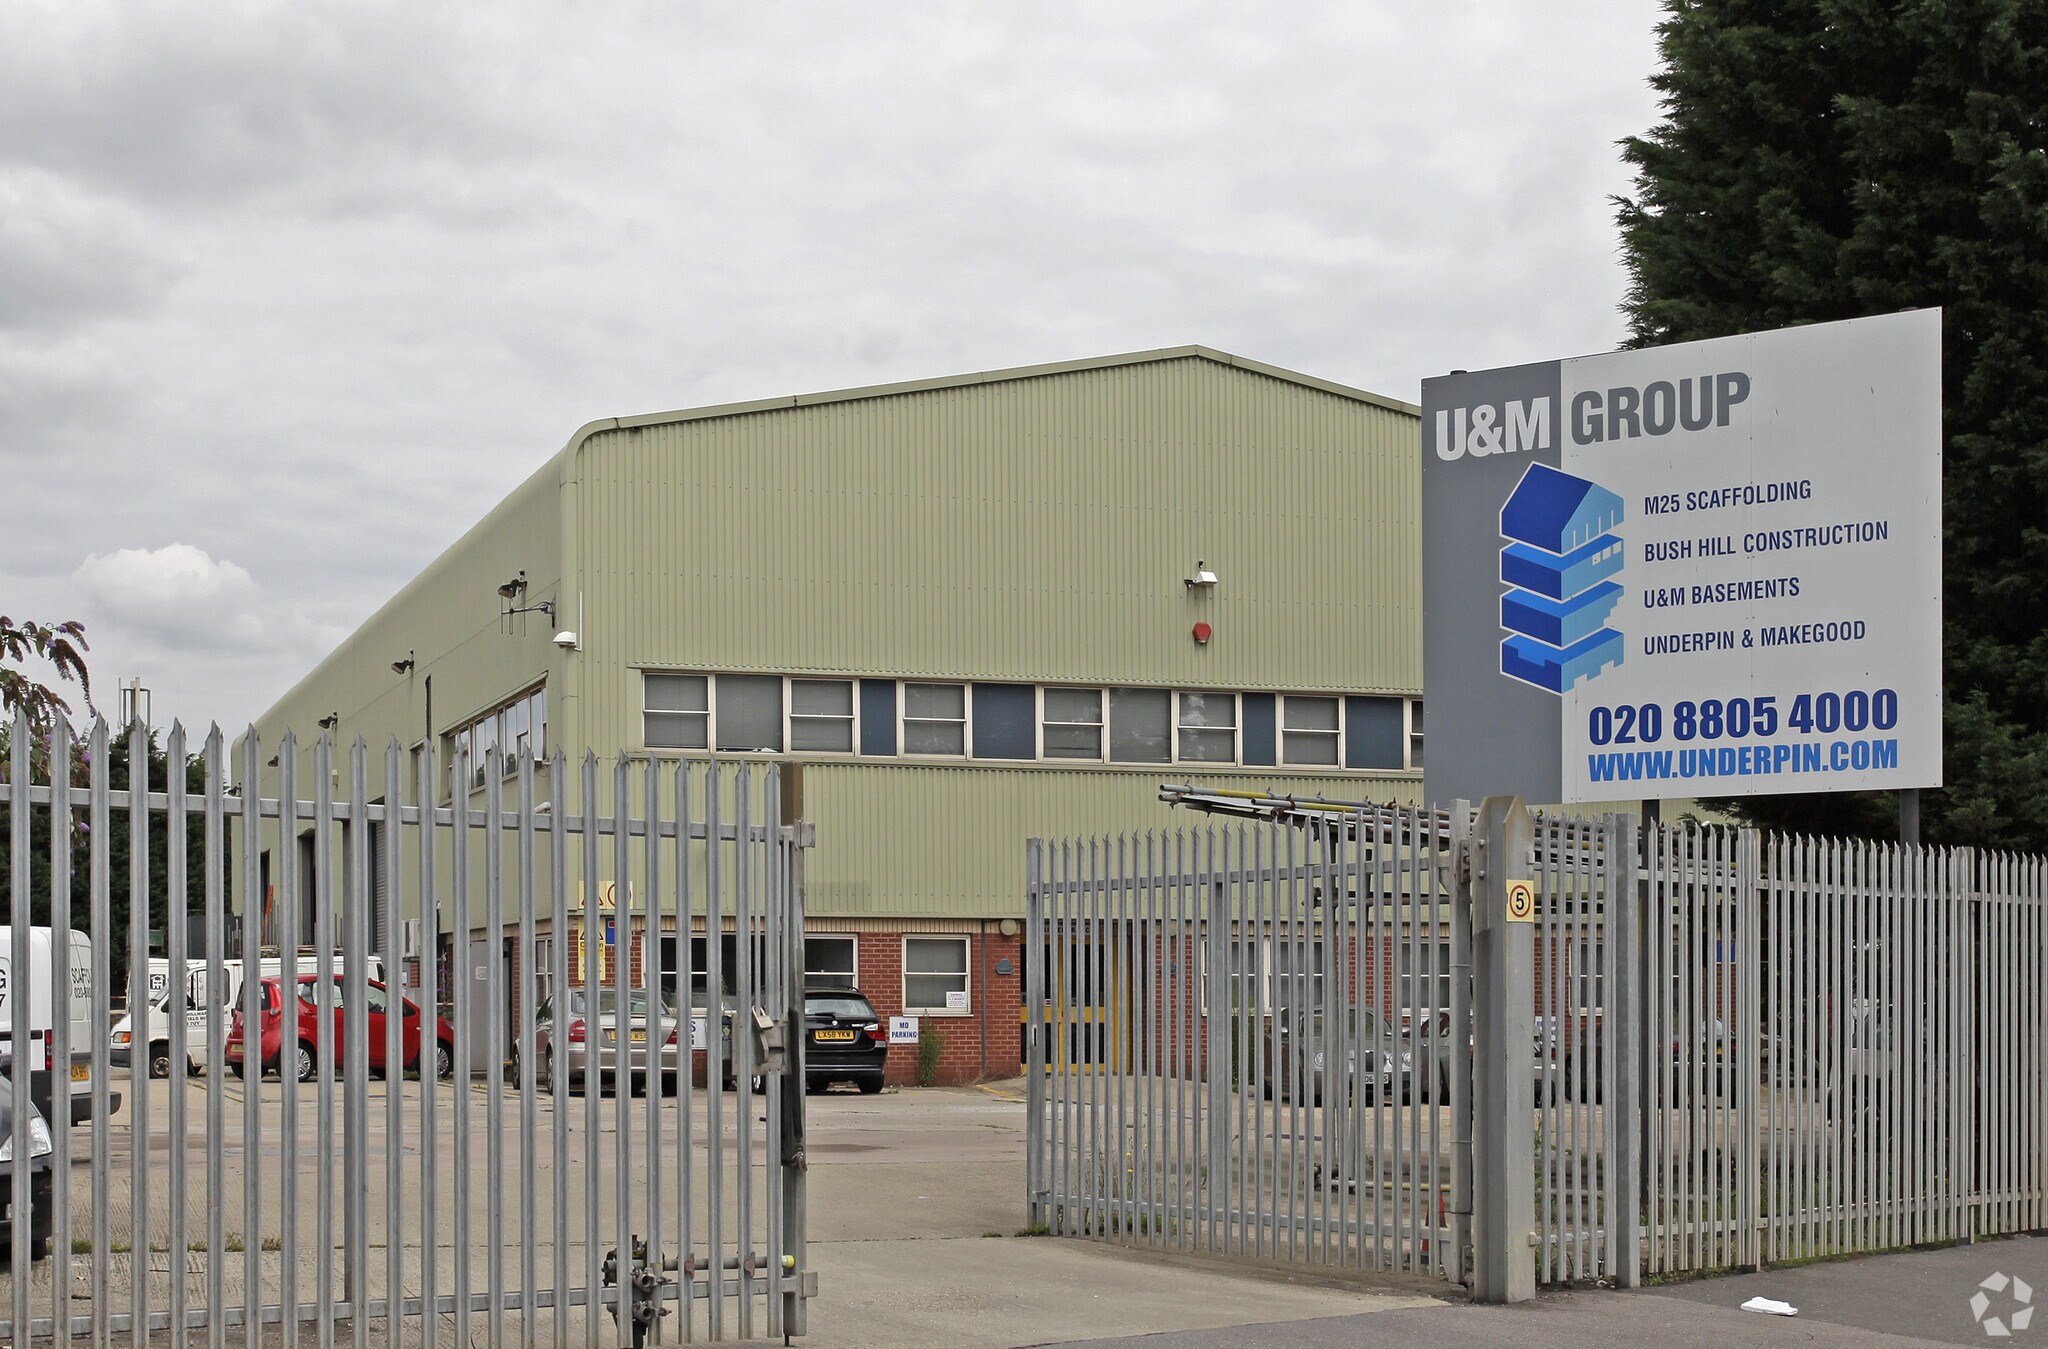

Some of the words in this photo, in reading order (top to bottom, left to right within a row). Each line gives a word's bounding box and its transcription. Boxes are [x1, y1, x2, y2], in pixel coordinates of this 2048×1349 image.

[1435, 396, 1550, 461] U&M
[1571, 371, 1750, 446] GROUP
[1644, 494, 1680, 515] M25
[1686, 479, 1811, 511] SCAFFOLDING
[1644, 539, 1692, 562] BUSH
[1698, 535, 1736, 557] HILL
[1743, 520, 1888, 553] CONSTRUCTION
[1644, 587, 1685, 608] U&M
[1691, 577, 1800, 605] BASEMENTS
[1644, 630, 1735, 655] UNDERPIN
[1741, 629, 1754, 648] &
[1760, 620, 1866, 647] MAKEGOOD
[1589, 703, 1662, 745] 020
[1673, 696, 1778, 741] 8805
[1788, 688, 1898, 734] 4000
[1588, 739, 1898, 782] WWW.UNDERPIN.COM
[1515, 892, 1525, 911] 5
[891, 1031, 917, 1039] PARKING
